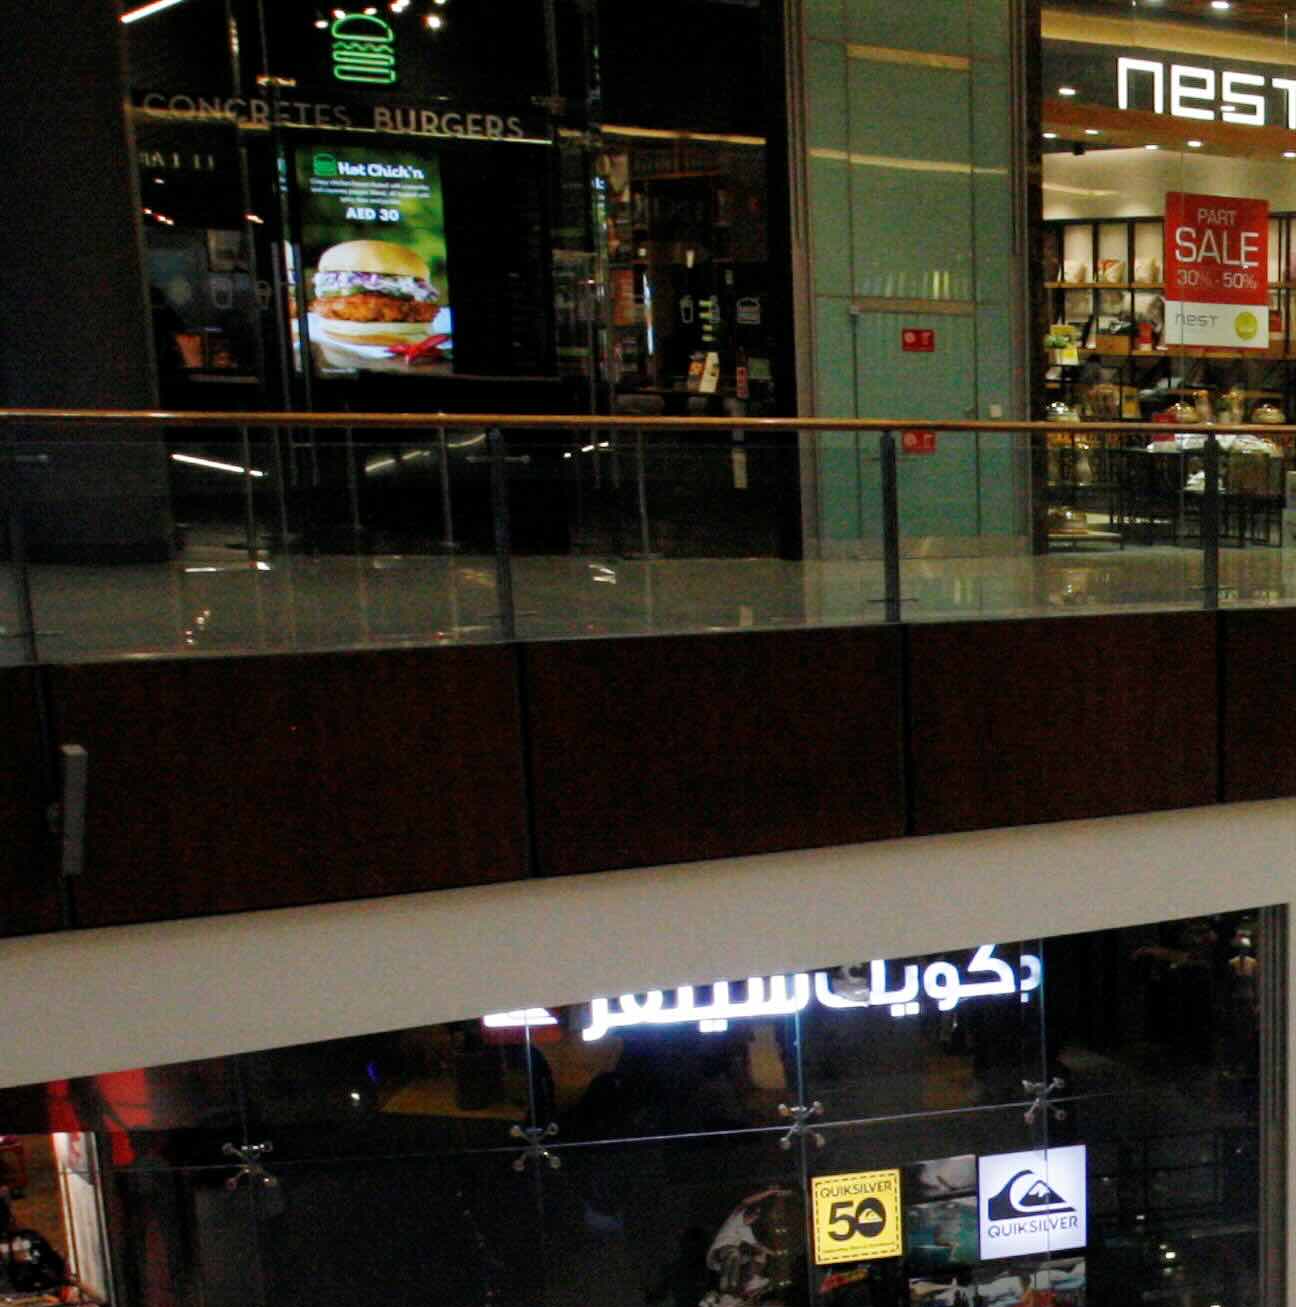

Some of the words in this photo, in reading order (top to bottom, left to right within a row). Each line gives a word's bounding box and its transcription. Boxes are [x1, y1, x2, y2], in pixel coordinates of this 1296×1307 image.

[143, 93, 351, 129] CONCRETES
[373, 106, 524, 139] BURGERS
[346, 207, 376, 221] AED
[379, 208, 401, 222] 30
[1197, 207, 1238, 225] PART
[1175, 226, 1260, 267] SALE
[1223, 271, 1258, 289] 50%
[819, 1179, 892, 1200] QUIKSILVER
[827, 1197, 887, 1242] 50
[986, 1214, 1080, 1240] QUIKSILVER
